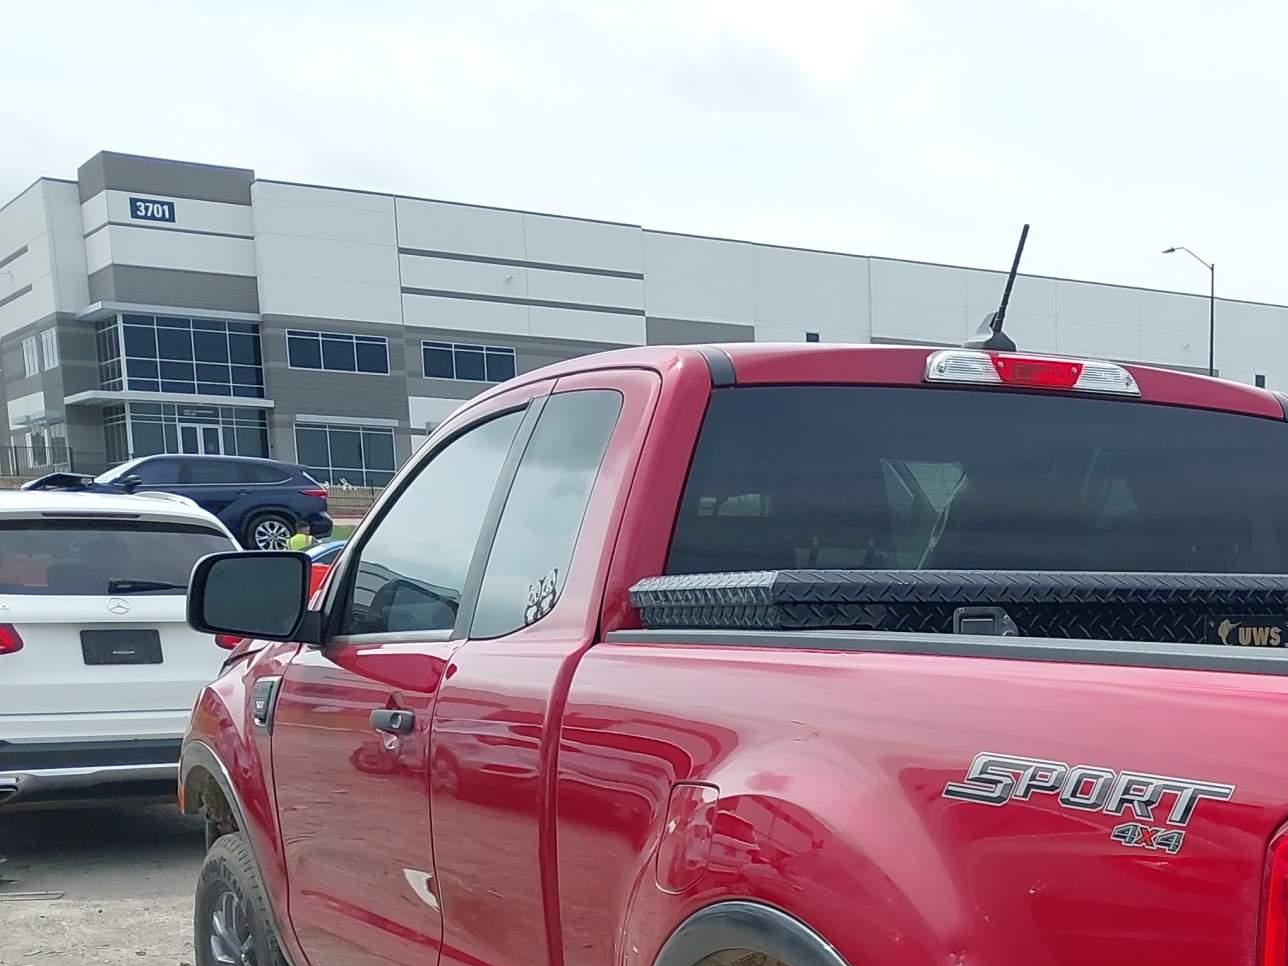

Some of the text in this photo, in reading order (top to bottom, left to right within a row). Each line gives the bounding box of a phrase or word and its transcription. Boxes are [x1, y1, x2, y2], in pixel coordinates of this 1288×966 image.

[135, 201, 169, 219] 3701
[1238, 626, 1281, 646] UWS
[942, 751, 1236, 827] SPORT
